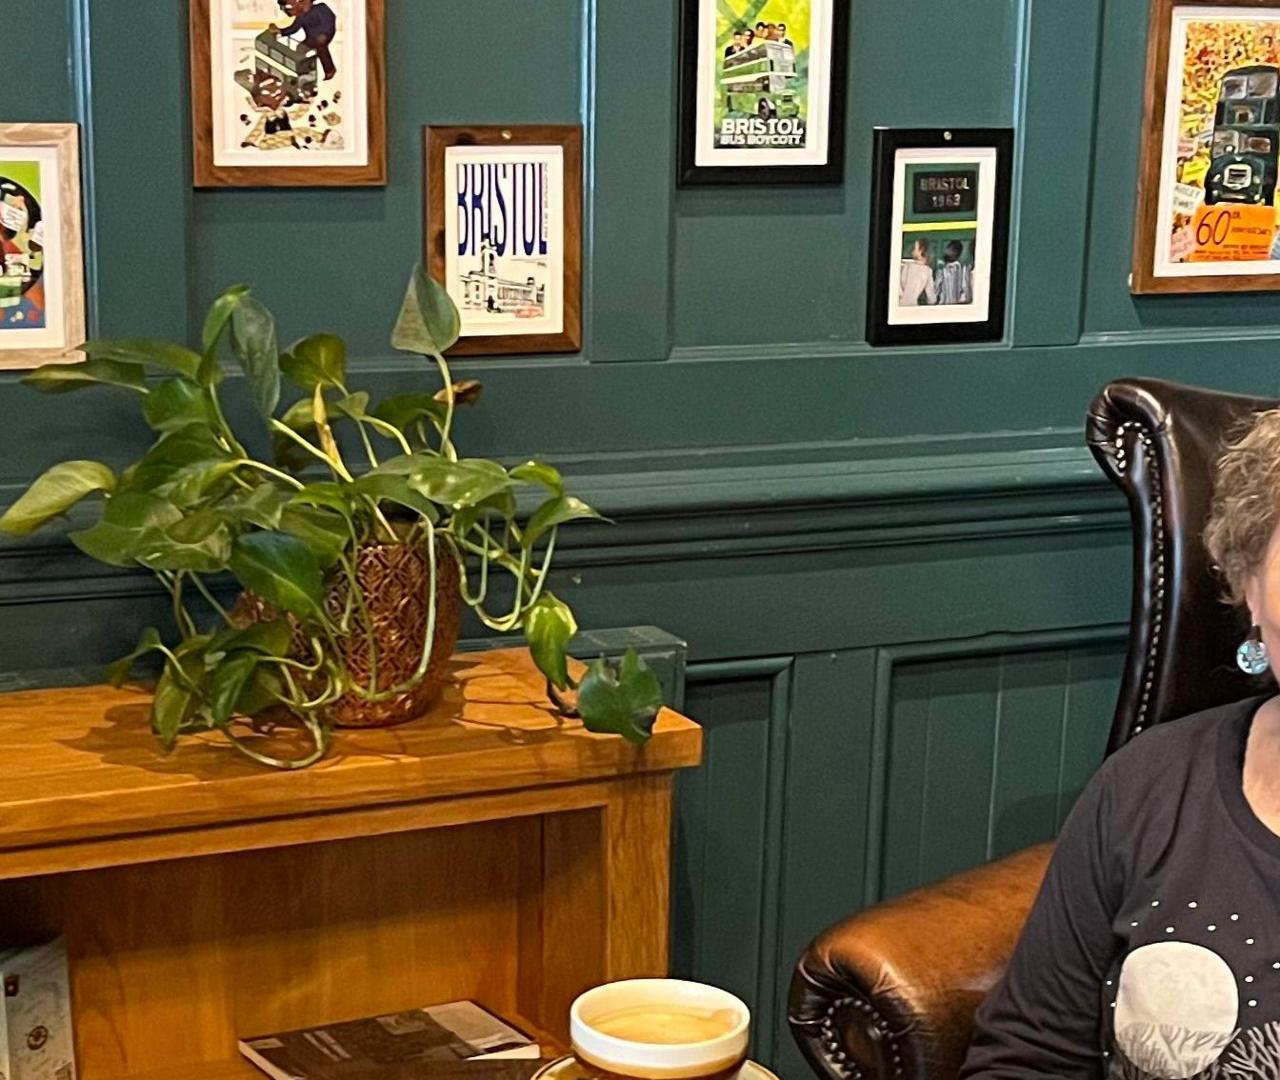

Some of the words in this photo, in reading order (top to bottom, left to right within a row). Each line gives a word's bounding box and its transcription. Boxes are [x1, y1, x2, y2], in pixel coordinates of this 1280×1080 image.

[721, 118, 803, 134] BRISTOL
[720, 134, 745, 145] BUS
[747, 134, 801, 145] BOYCOTT
[921, 177, 970, 191] BRISTOL
[932, 193, 961, 207] 1963
[457, 163, 547, 257] BRISTOL
[1196, 210, 1232, 246] 60
